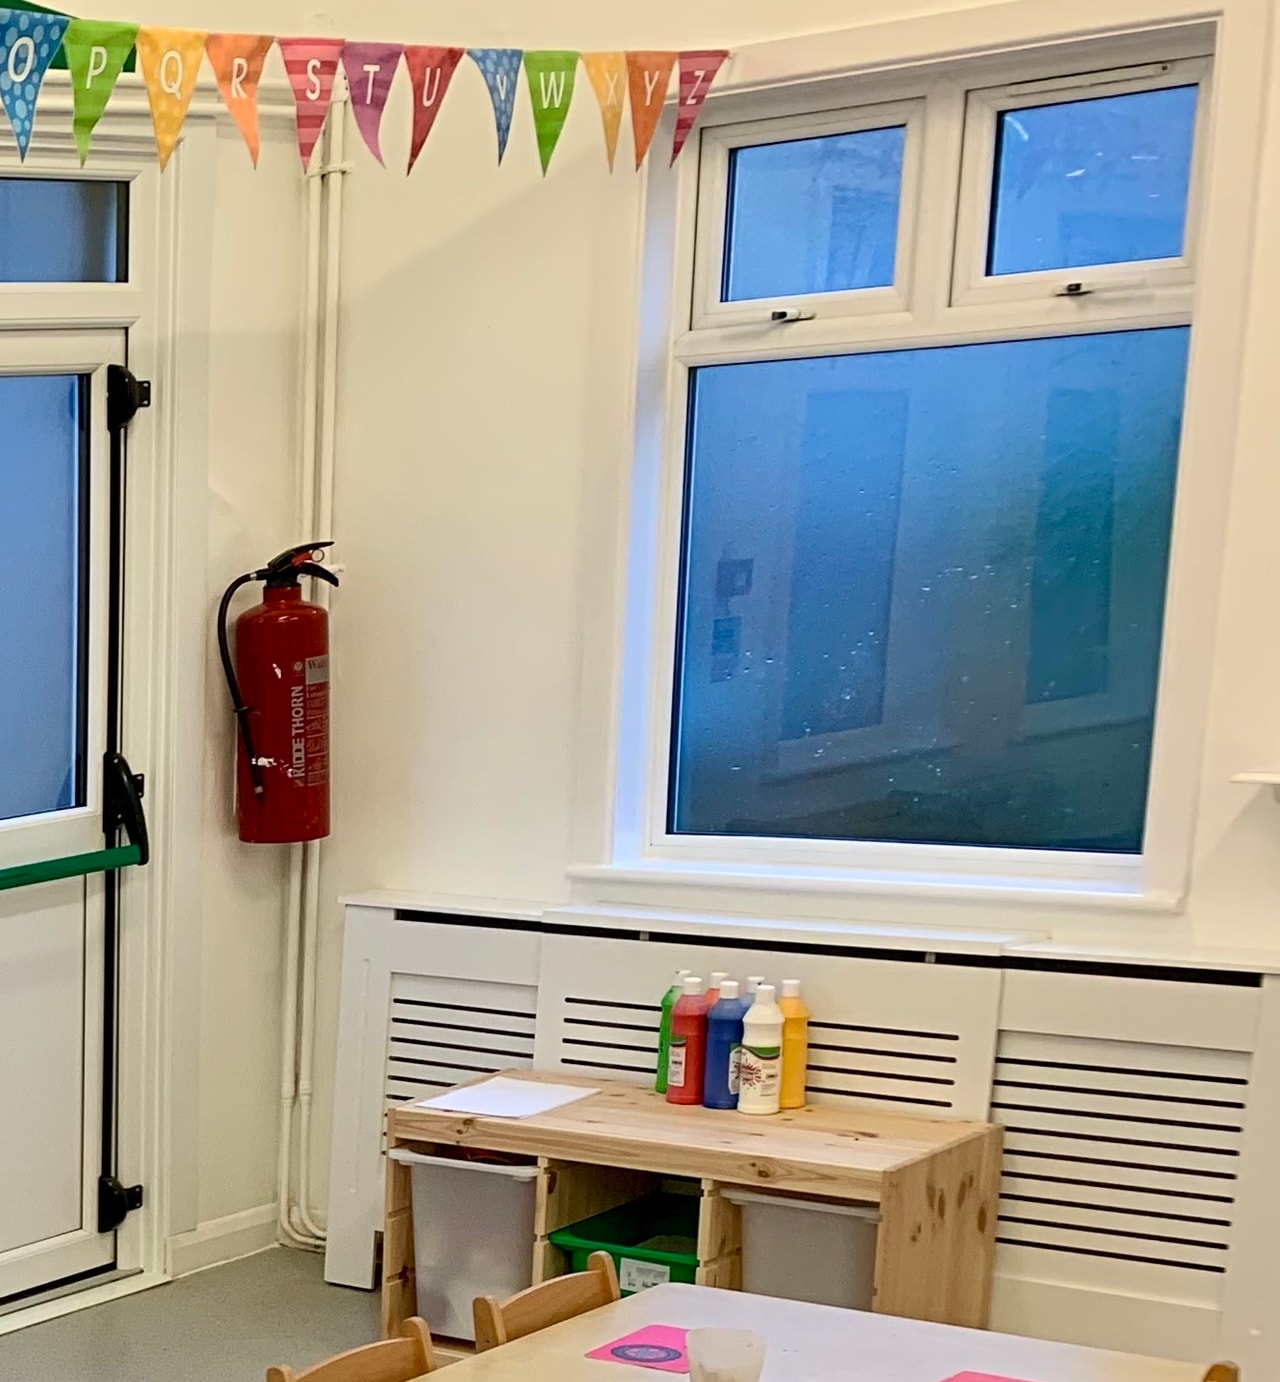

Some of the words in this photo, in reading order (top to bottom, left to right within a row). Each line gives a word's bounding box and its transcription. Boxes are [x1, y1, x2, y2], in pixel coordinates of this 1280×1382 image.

[7, 36, 35, 83] O
[86, 46, 107, 90] P
[160, 50, 182, 100] Q
[231, 58, 248, 99] R
[305, 59, 321, 100] S
[363, 64, 380, 105] T
[423, 67, 441, 107] U
[539, 71, 565, 109] W
[604, 71, 618, 106] X
[644, 70, 659, 107] Y
[685, 70, 704, 105] Z
[291, 686, 304, 736] THORN
[292, 738, 305, 777] KIDDE
